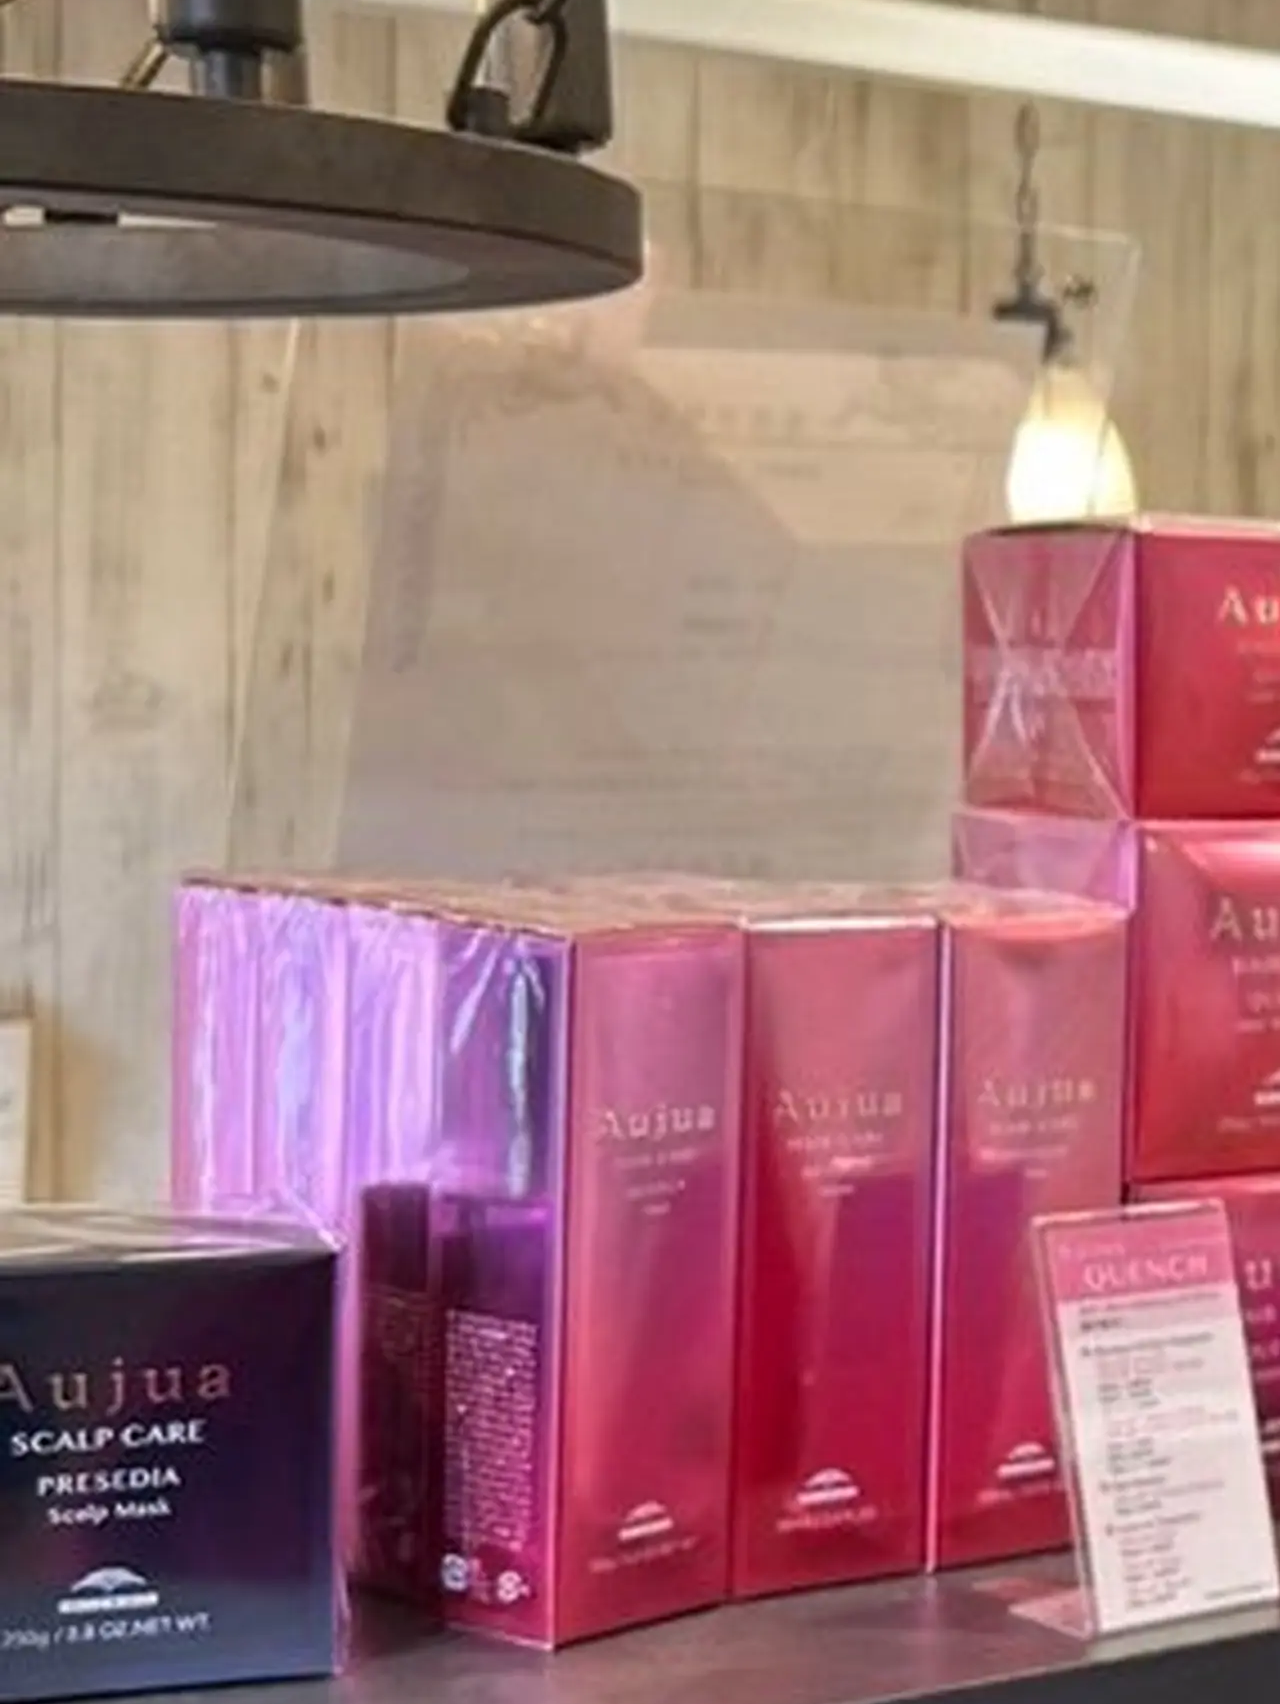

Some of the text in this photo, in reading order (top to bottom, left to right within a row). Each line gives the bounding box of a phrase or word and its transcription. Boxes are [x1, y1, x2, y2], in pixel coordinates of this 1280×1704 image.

[597, 1103, 716, 1141] Aujua
[774, 1090, 904, 1123] Aujua
[1084, 1254, 1207, 1290] QUENCH
[0, 1356, 232, 1416] Aujua
[10, 1418, 208, 1457] SCALP CARE
[36, 1466, 181, 1497] PRESEDIA
[48, 1496, 171, 1526] Scalp Mask
